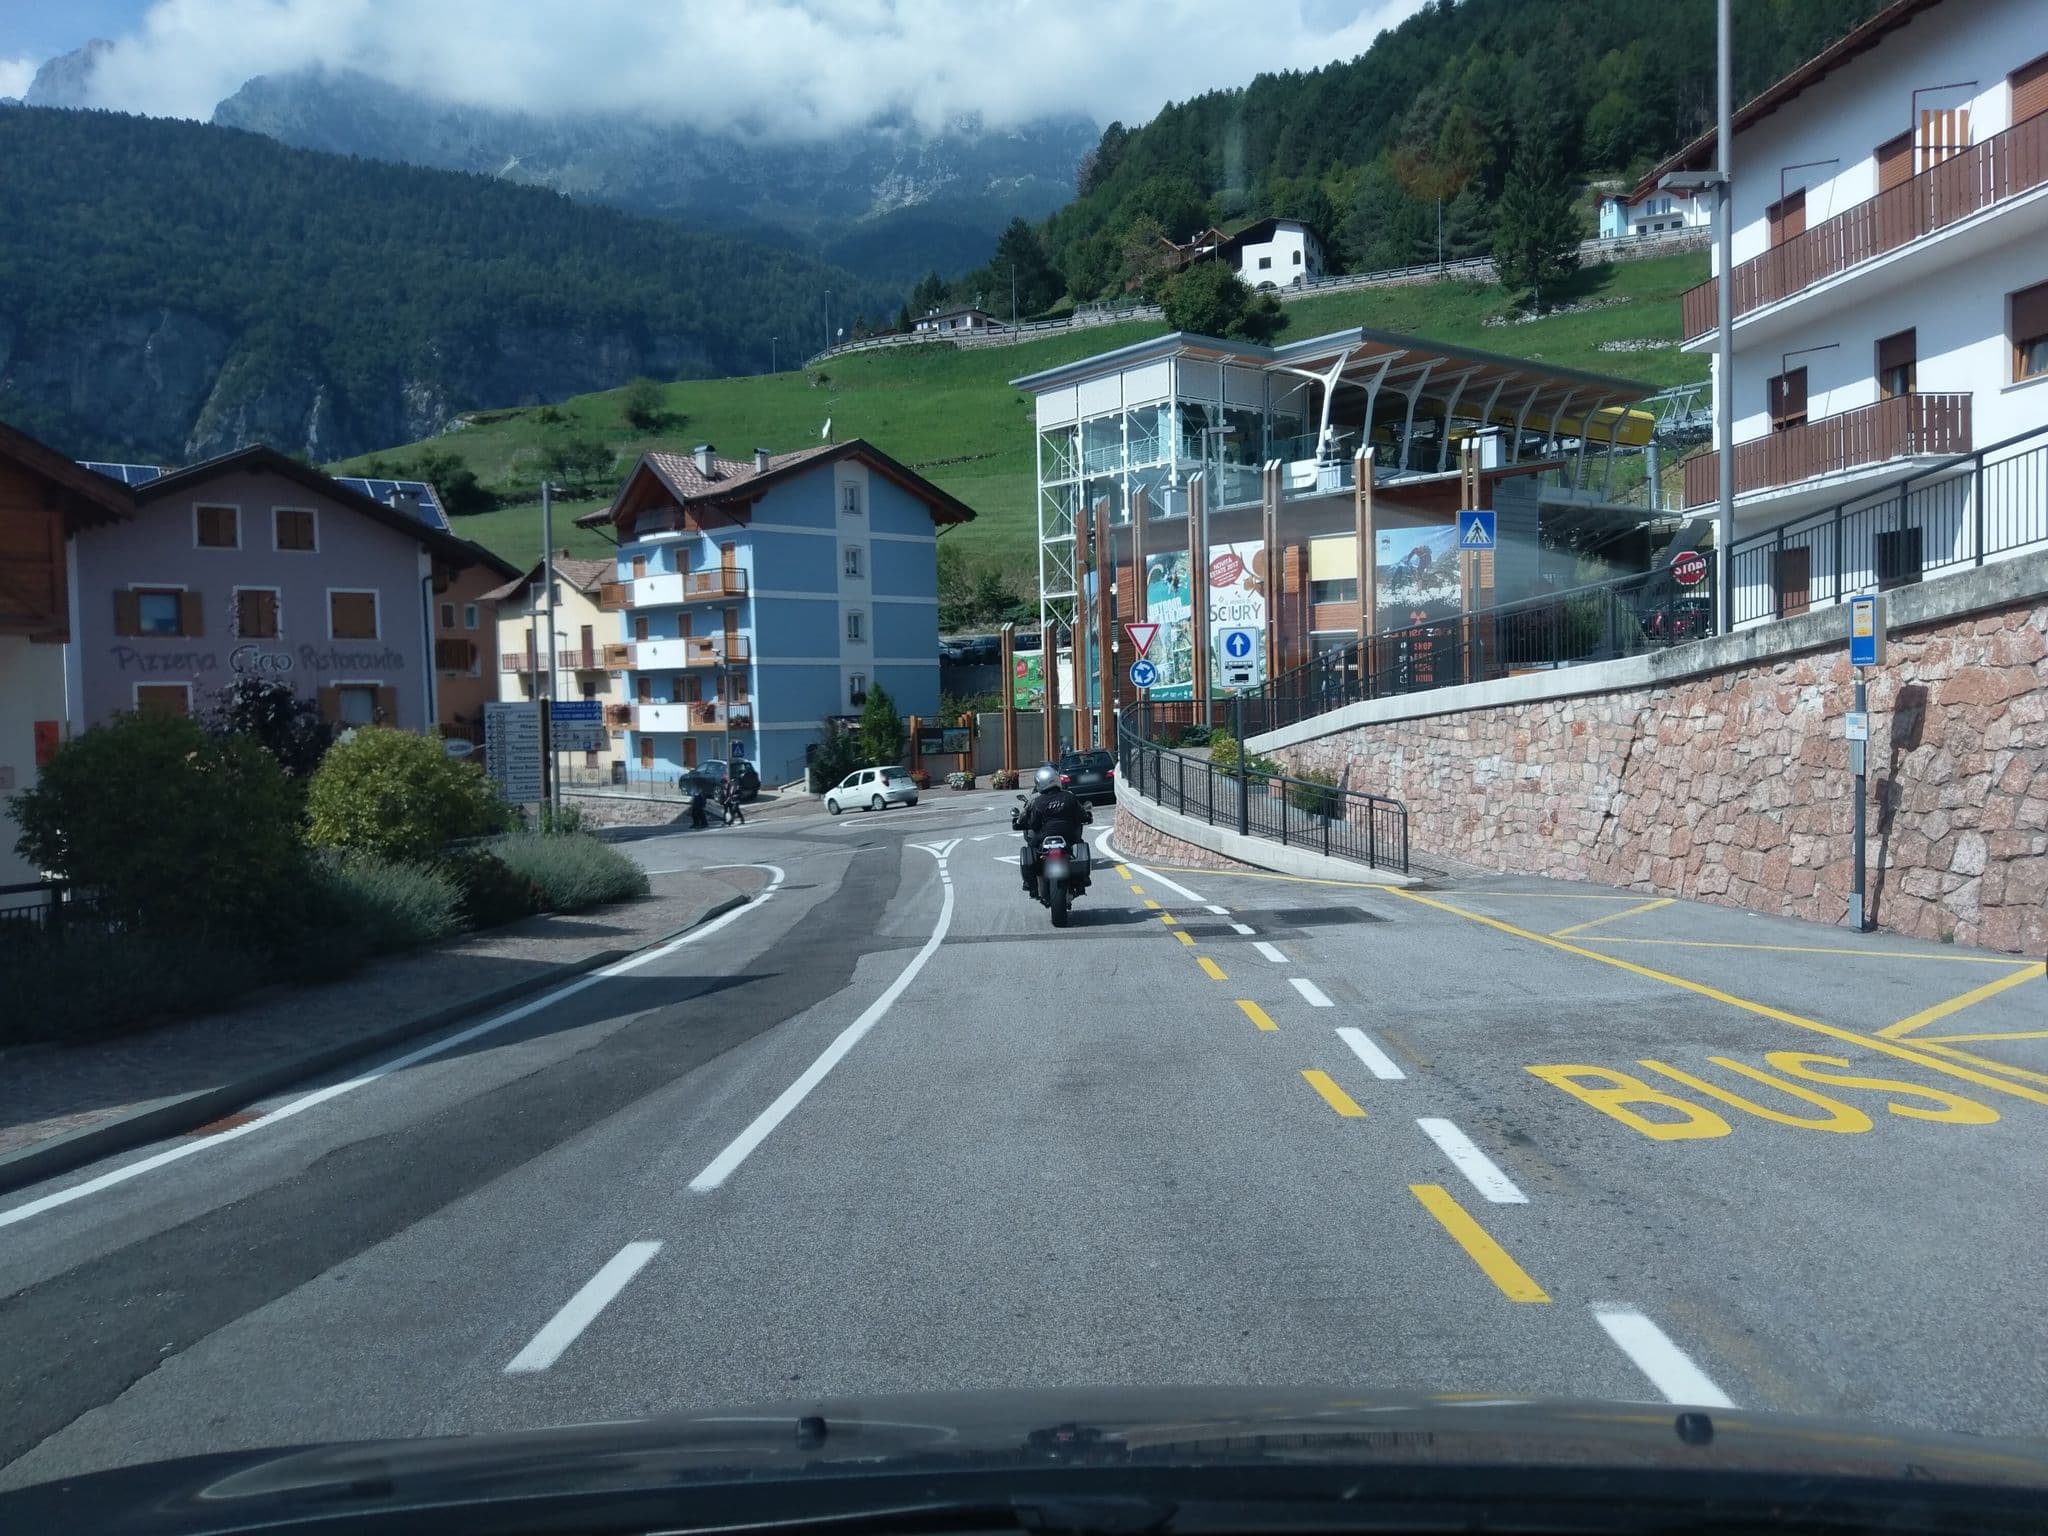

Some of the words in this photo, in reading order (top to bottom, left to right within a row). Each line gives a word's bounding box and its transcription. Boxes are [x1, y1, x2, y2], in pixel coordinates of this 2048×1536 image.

[1674, 561, 1704, 575] STOP
[1210, 603, 1262, 622] SCIURY
[110, 645, 217, 672] Pizzeria
[229, 645, 294, 672] Ciao
[298, 644, 406, 671] Ristorante
[1524, 1052, 2001, 1140] BUS
